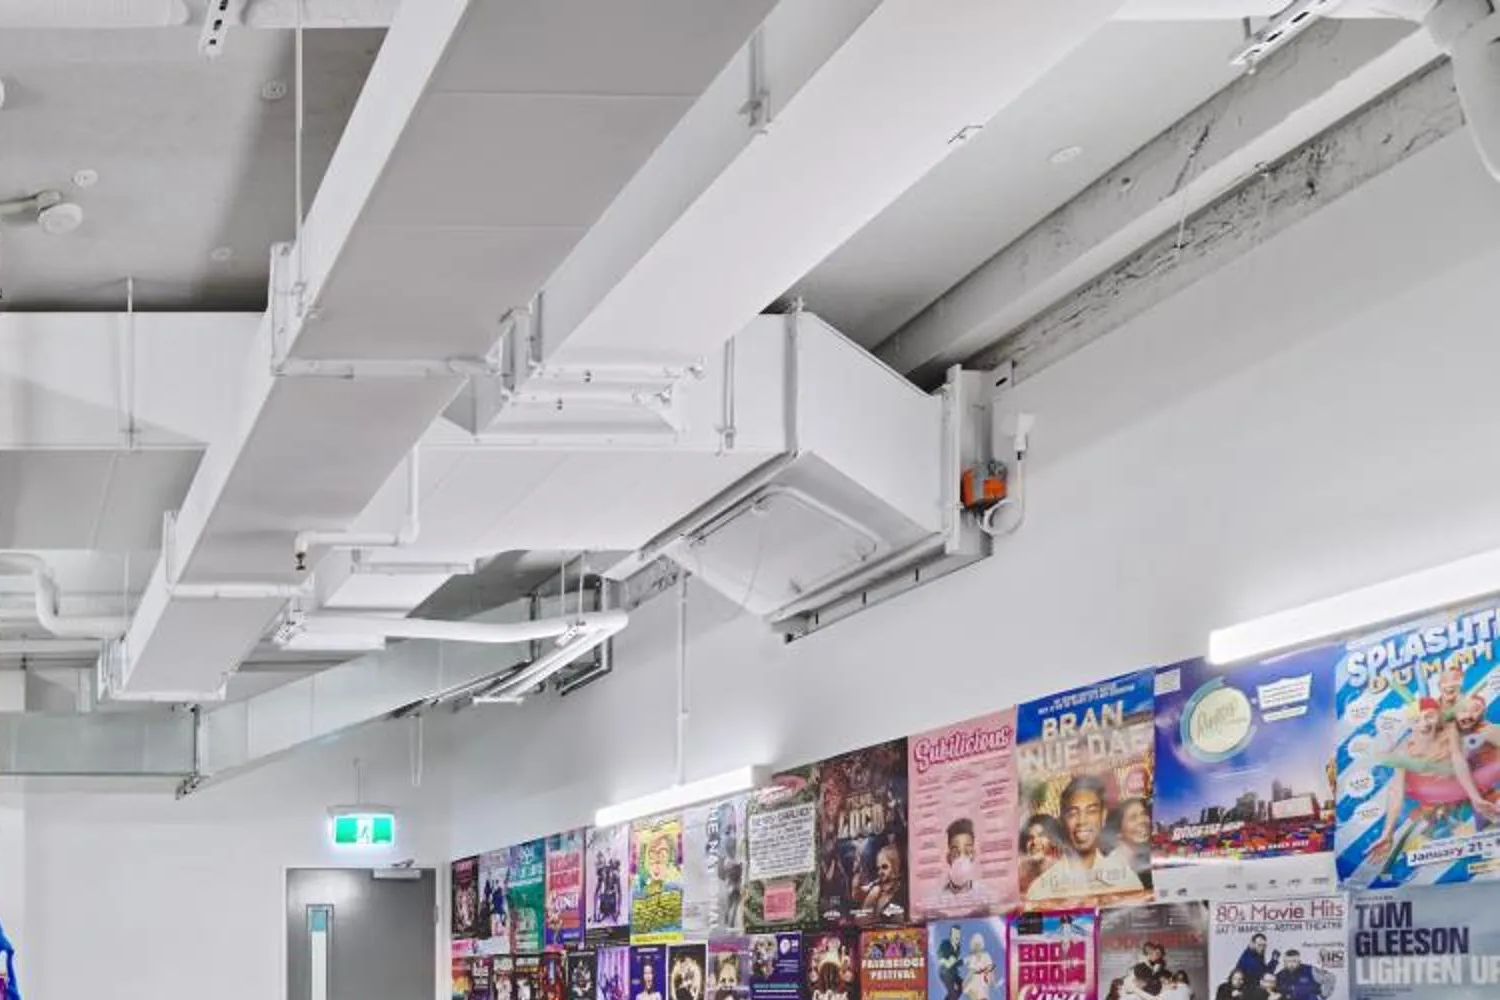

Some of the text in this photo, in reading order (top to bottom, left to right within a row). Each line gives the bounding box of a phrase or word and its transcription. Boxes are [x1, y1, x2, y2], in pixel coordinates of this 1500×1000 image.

[1041, 700, 1124, 742] BRAN
[1410, 844, 1463, 862] January
[1216, 898, 1344, 924] 80s Movie Hits
[1355, 901, 1413, 929] TOM
[1018, 941, 1086, 962] BOOM
[1355, 926, 1469, 958] GLEESON
[1018, 962, 1086, 990] BOOM
[1355, 955, 1462, 986] LIGHTEN
